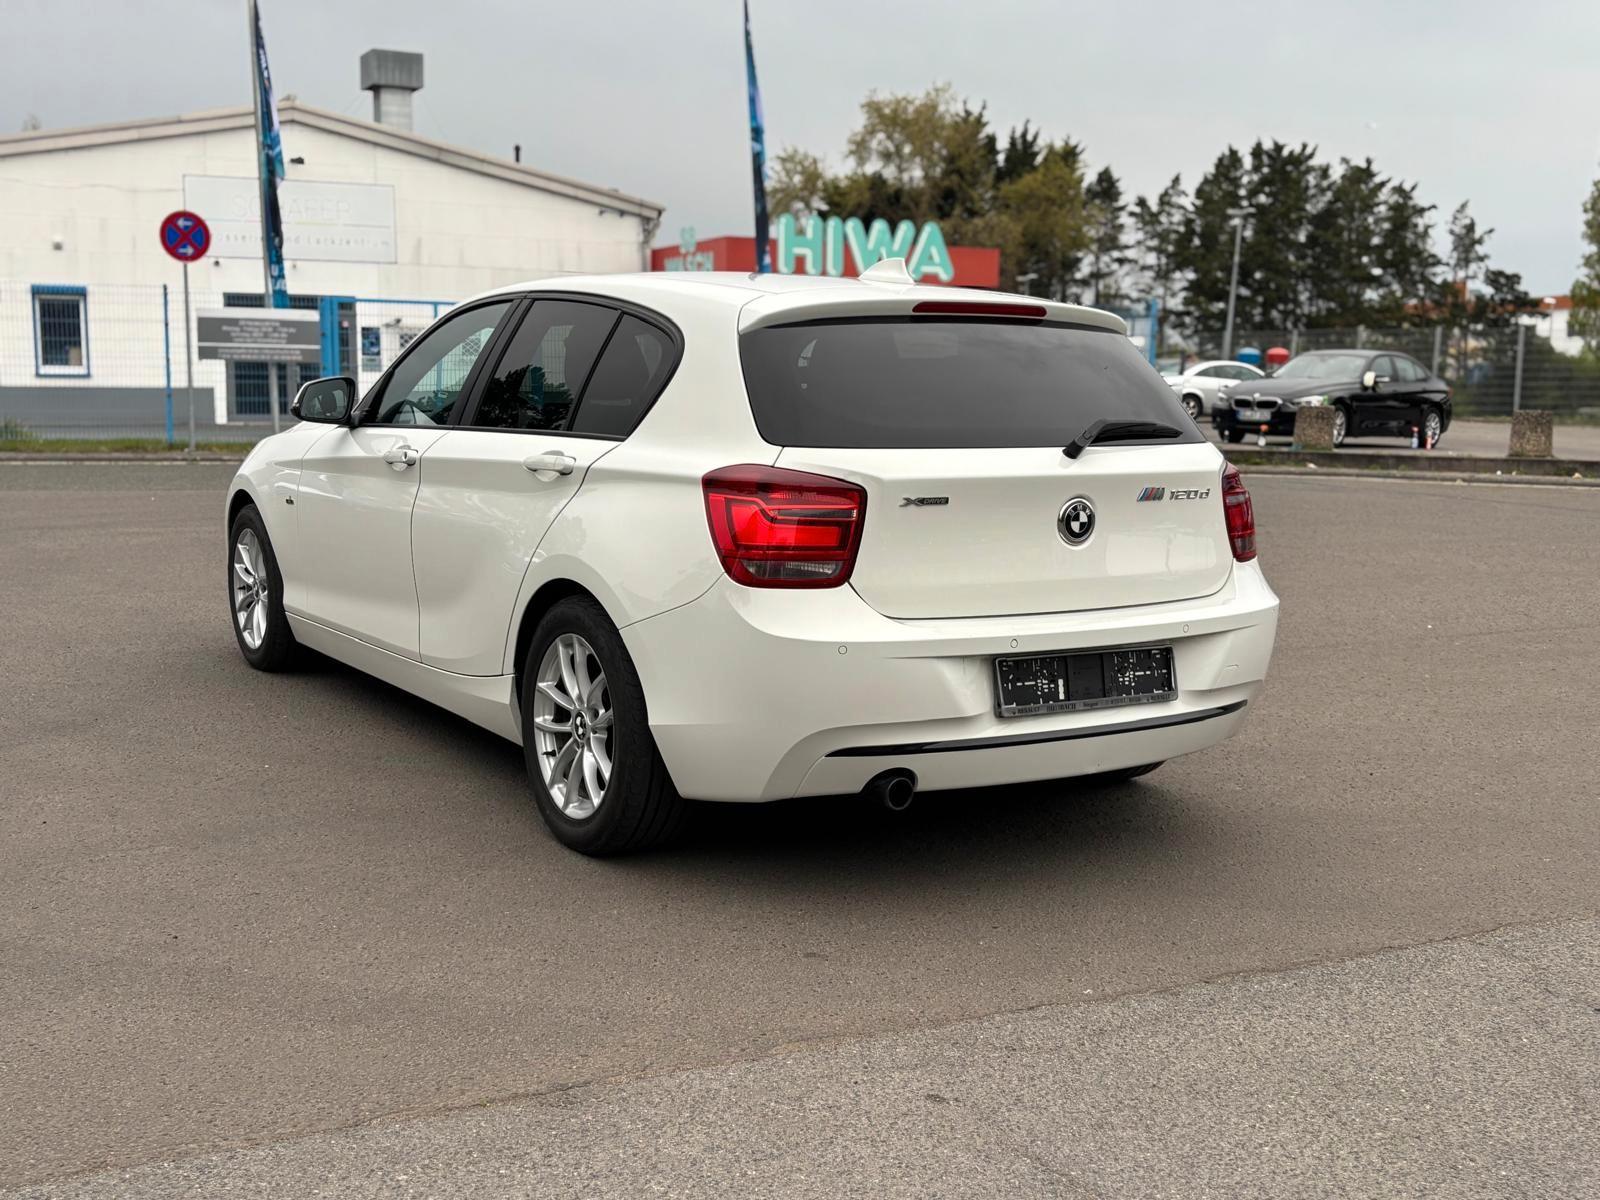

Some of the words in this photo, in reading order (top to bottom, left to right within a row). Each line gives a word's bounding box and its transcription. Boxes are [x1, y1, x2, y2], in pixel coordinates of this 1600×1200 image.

[777, 213, 955, 282] HIWA
[1169, 488, 1211, 501] 120d
[1068, 503, 1092, 517] BMW
